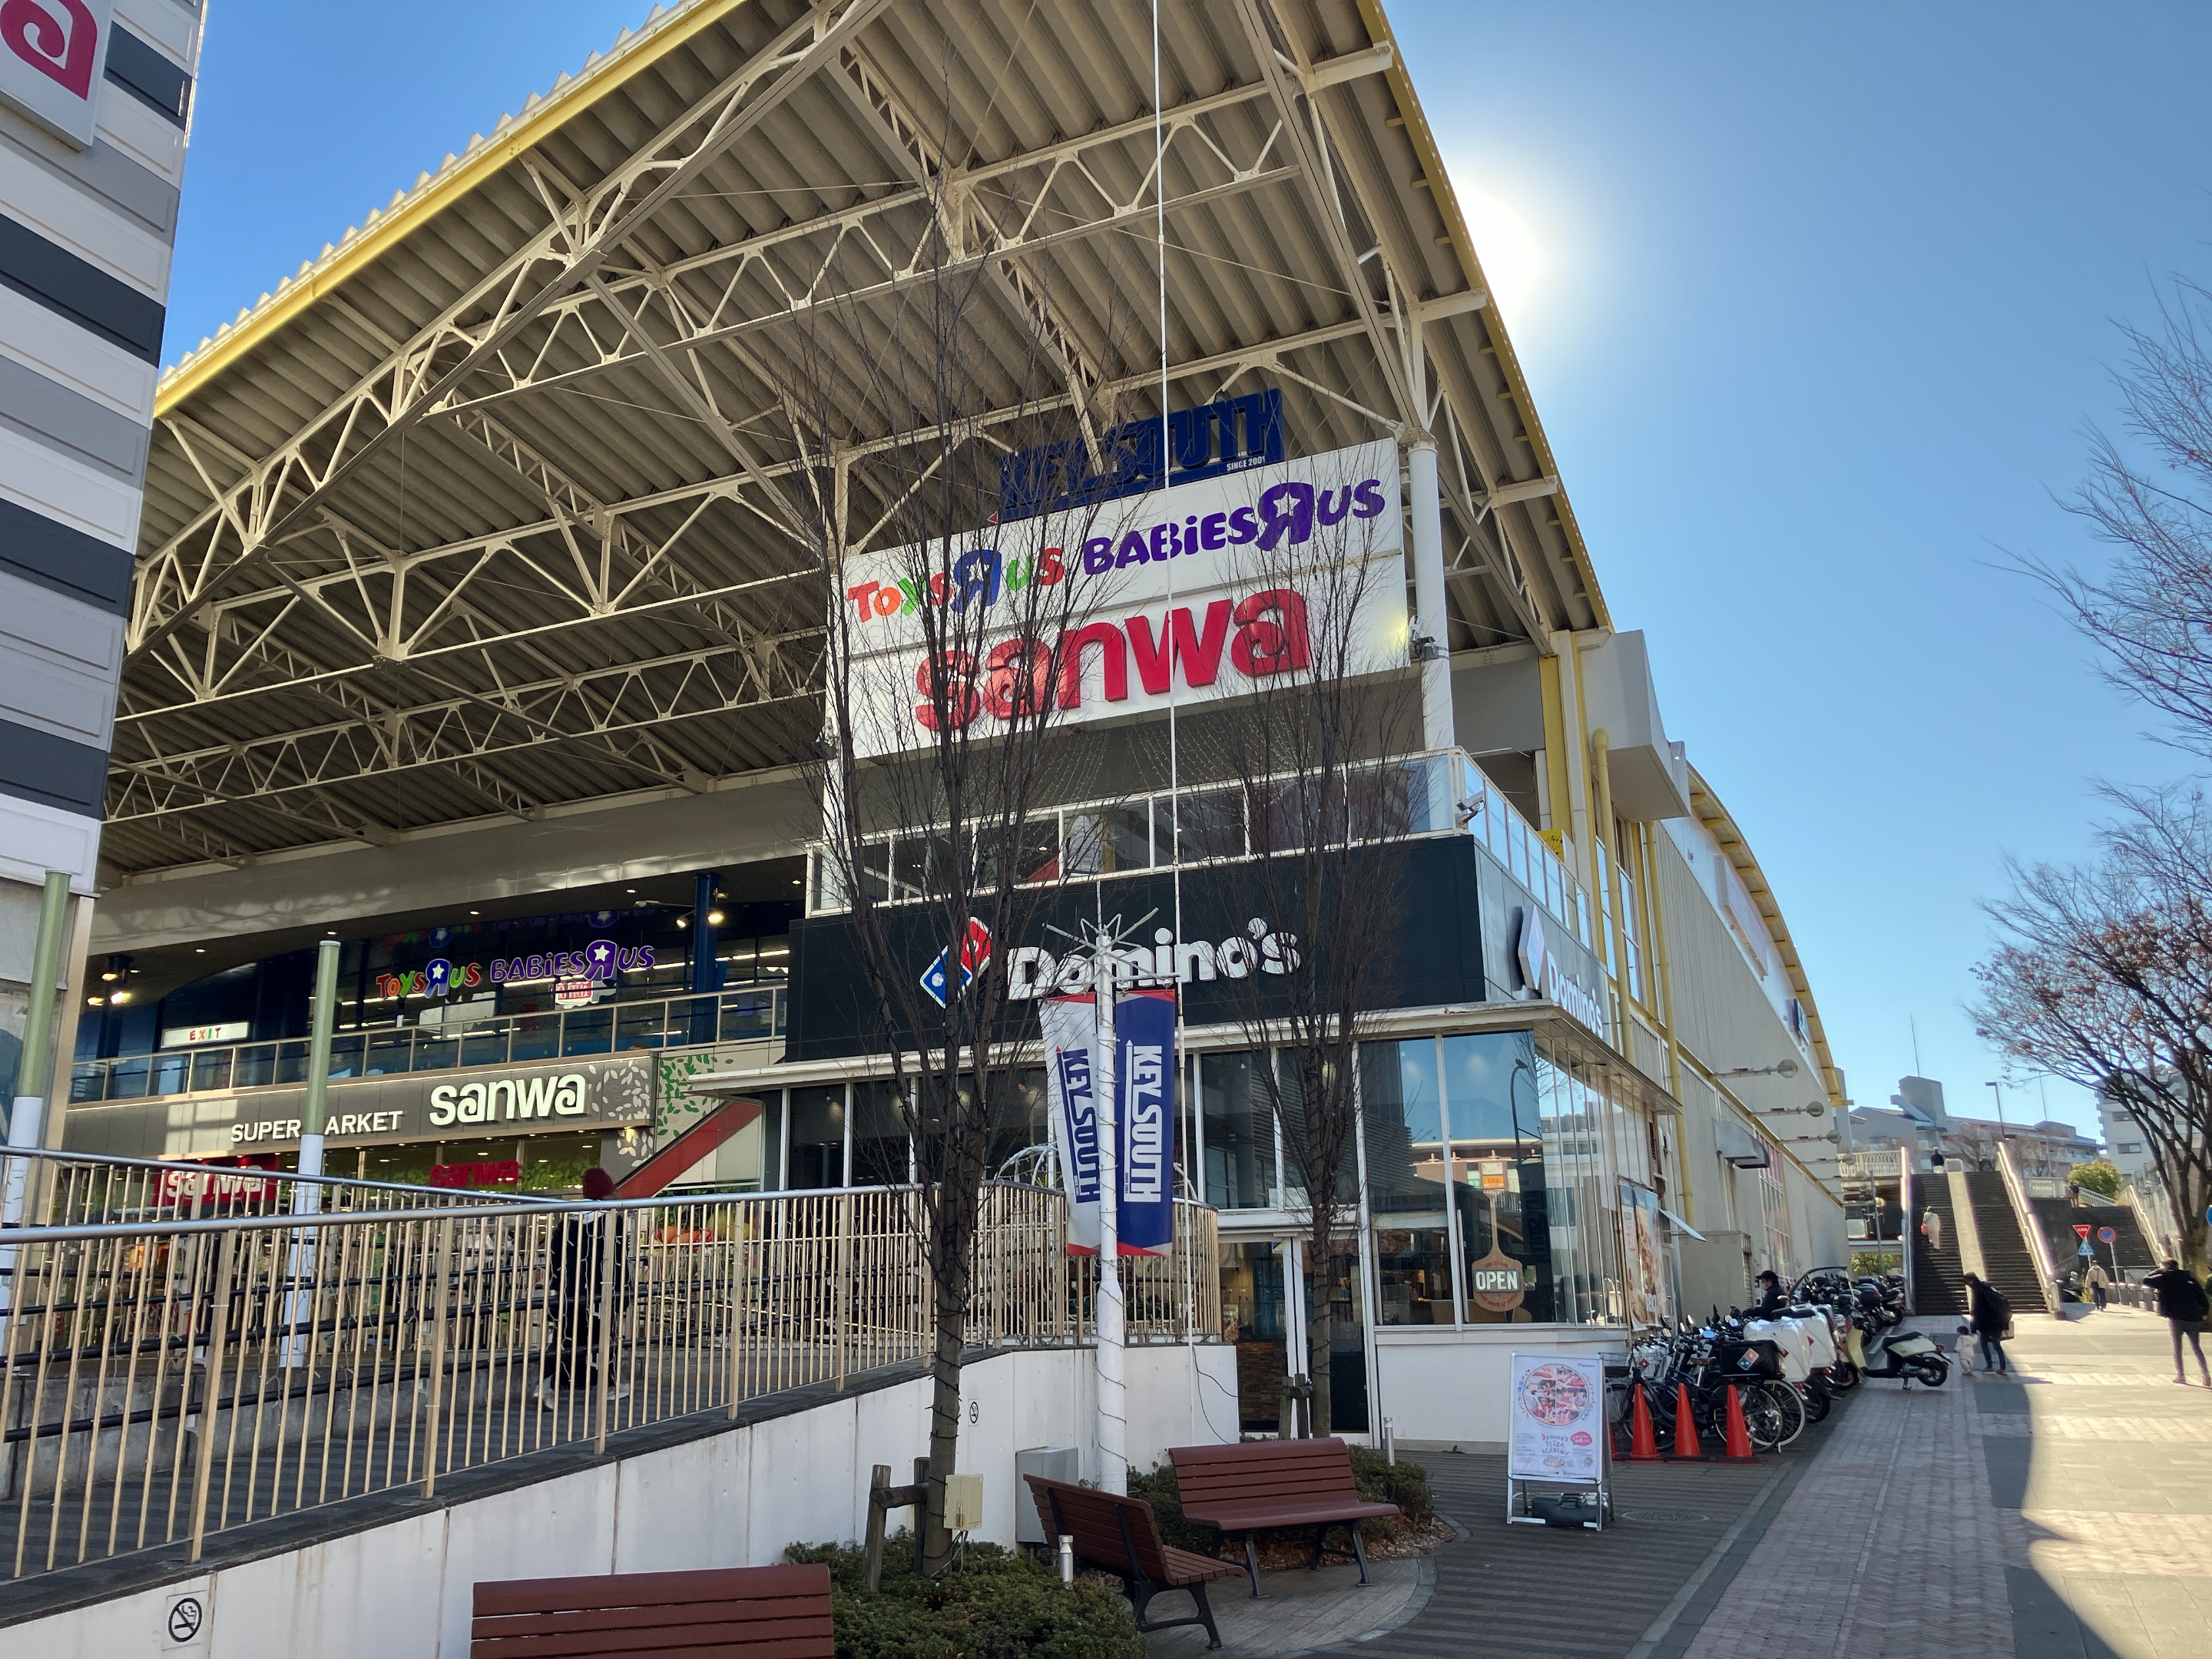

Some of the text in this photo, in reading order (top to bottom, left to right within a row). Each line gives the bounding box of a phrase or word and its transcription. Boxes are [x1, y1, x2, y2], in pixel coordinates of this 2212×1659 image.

[1227, 455, 1265, 471] SINCE 2001
[916, 588, 1311, 733] sanwa
[1007, 917, 1302, 1001] Domino's
[1547, 949, 1604, 1039] Domino's
[189, 1027, 222, 1041] EXIT
[1063, 1048, 1093, 1099] KEY
[429, 1074, 587, 1126] sanwa
[1129, 1045, 1163, 1203] KEY SOUTH
[429, 1160, 519, 1188] sanwa
[1475, 1270, 1518, 1290] OPEN
